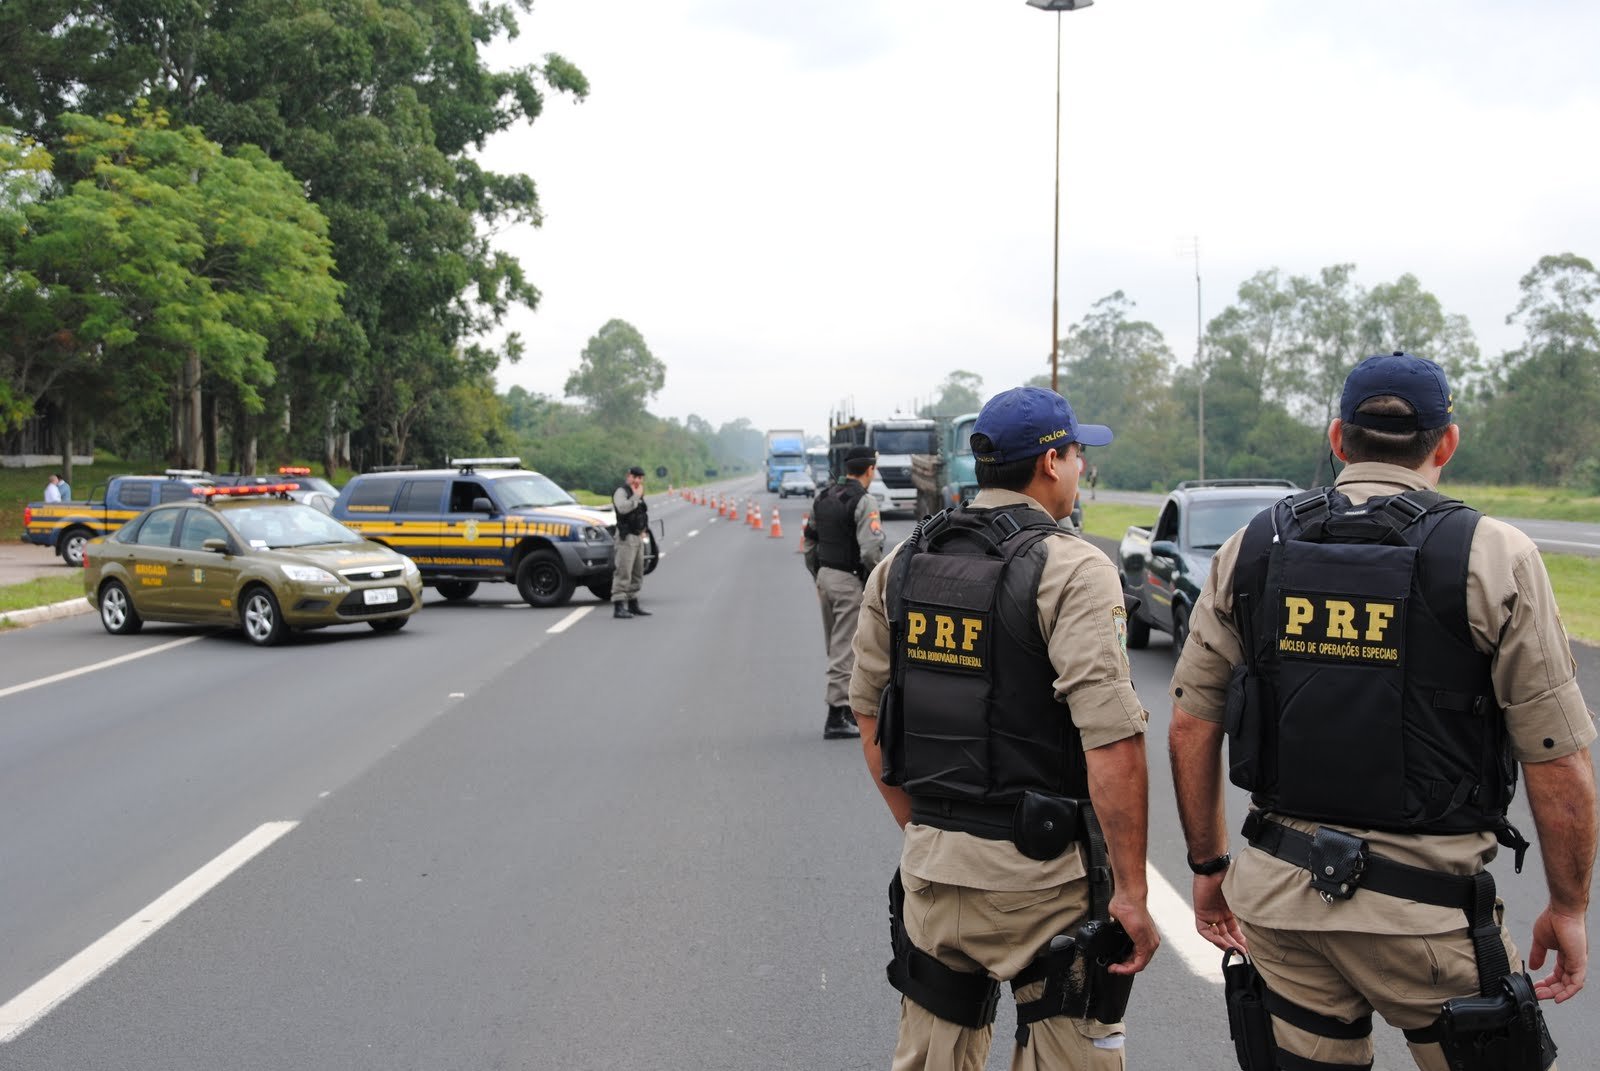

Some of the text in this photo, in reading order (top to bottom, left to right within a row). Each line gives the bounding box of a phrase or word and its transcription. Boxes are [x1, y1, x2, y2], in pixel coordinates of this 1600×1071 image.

[1039, 428, 1068, 445] POLÍCIA
[135, 564, 167, 576] BRIGADA
[1279, 637, 1398, 660] NÚCLEO DE OPERAÇÕES ESPECIAIS
[907, 648, 927, 660] POLÍCIA
[959, 655, 982, 668] FEDERAL
